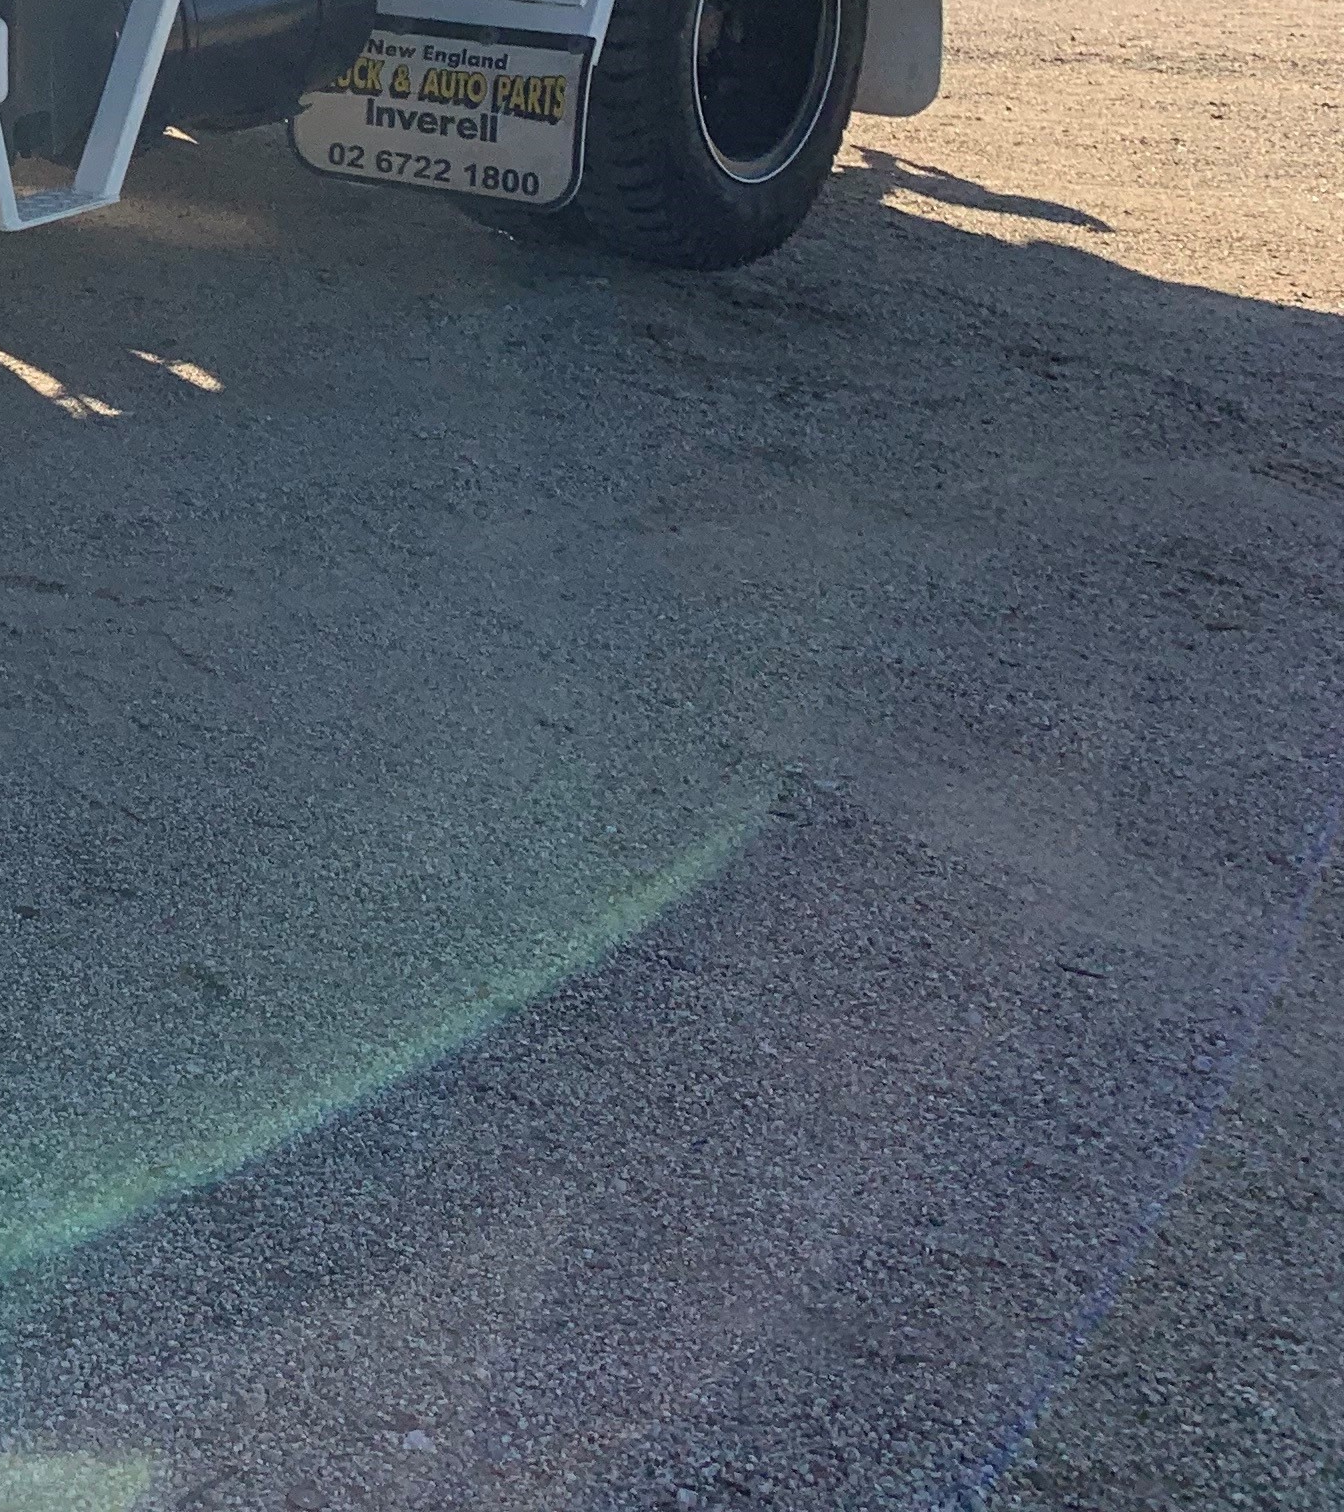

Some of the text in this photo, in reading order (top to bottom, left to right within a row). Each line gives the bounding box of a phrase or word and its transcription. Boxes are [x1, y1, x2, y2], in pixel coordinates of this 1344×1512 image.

[368, 38, 509, 71] New England
[390, 63, 411, 99] &
[418, 66, 487, 109] AUTO
[492, 74, 567, 126] PARTS
[365, 98, 499, 143] Inverell
[328, 141, 540, 197] 02 6722 1800
